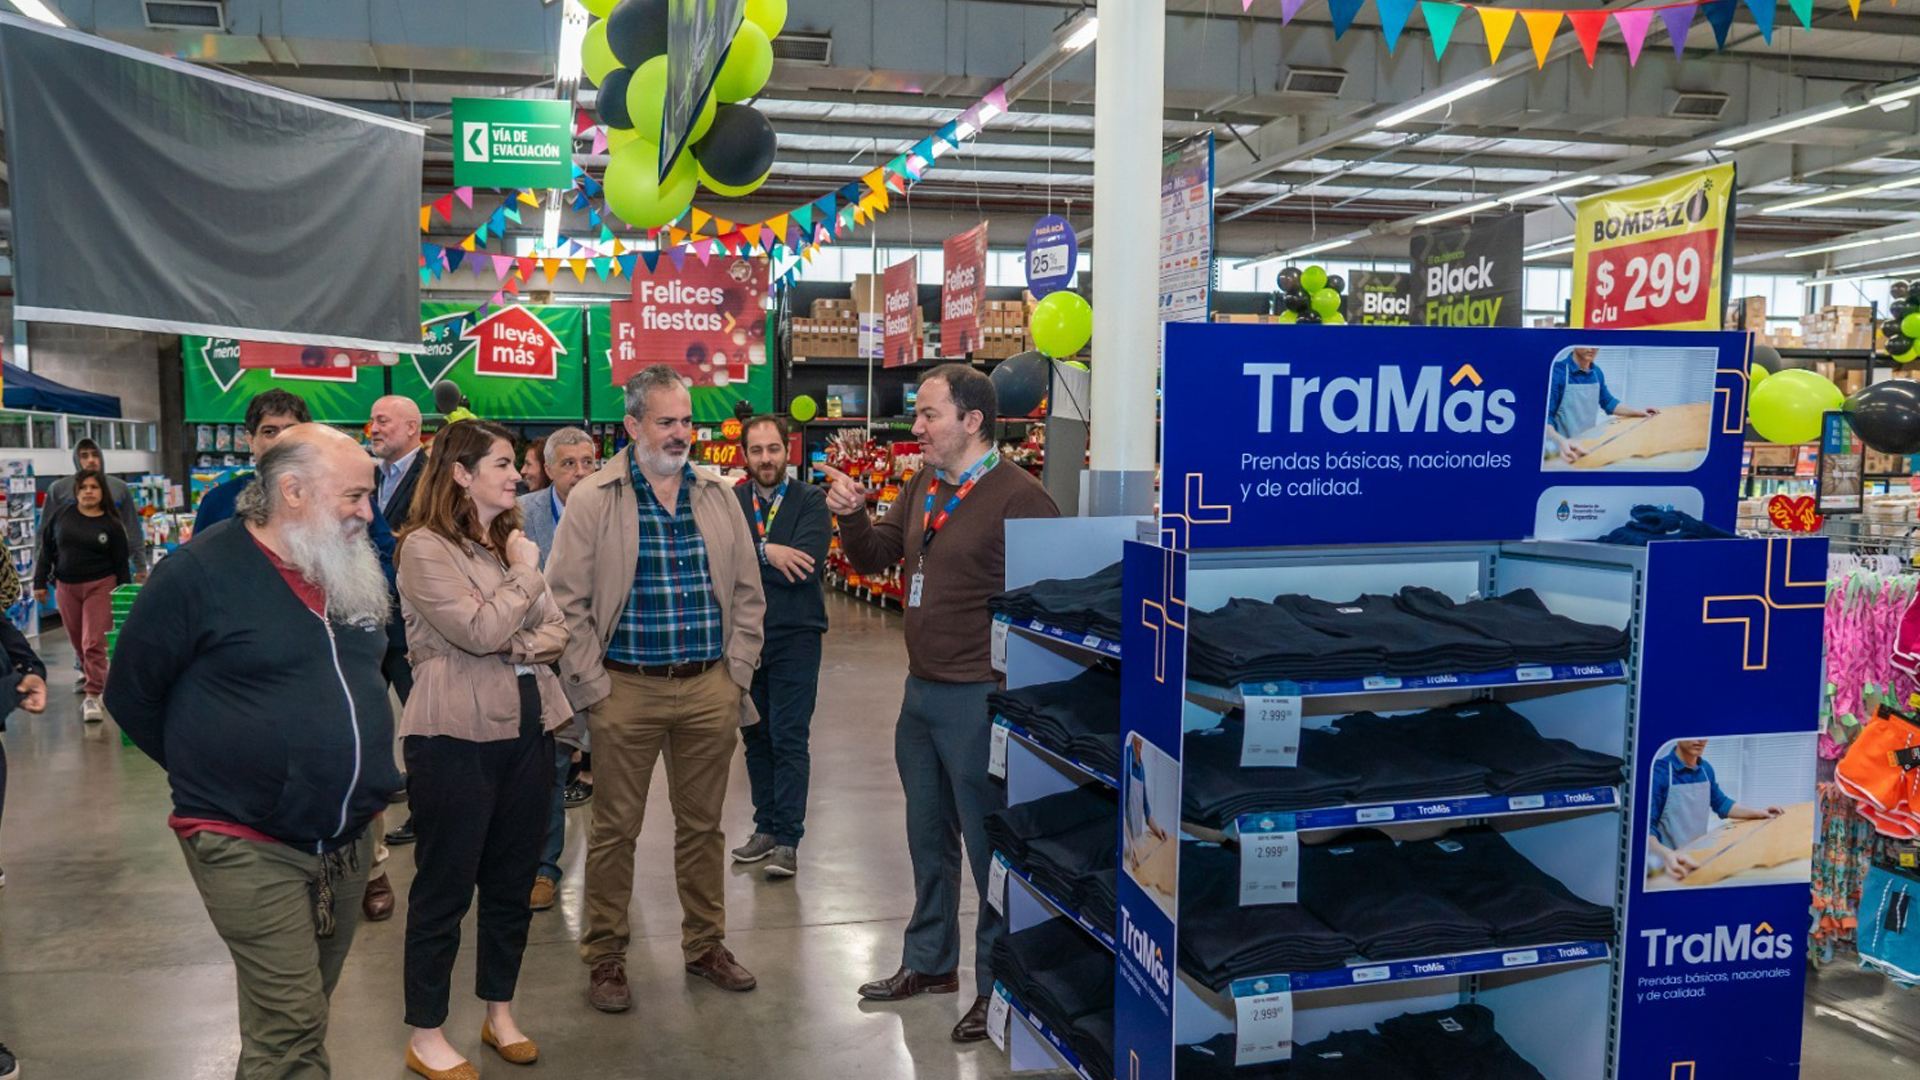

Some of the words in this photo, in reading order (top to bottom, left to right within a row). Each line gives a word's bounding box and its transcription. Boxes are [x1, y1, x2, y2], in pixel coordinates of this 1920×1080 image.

[492, 127, 511, 142] VÍA
[513, 130, 528, 142] DE
[493, 143, 560, 158] EVACUACIÓN
[946, 263, 975, 292] Felices
[1427, 256, 1494, 297] Black
[1624, 248, 1700, 311] 299
[641, 279, 724, 304] Felices
[886, 289, 909, 313] Felices
[642, 305, 722, 331] fiestas
[945, 294, 973, 320] fiestas
[1426, 295, 1503, 327] Friday
[1592, 303, 1618, 323] c/u
[493, 322, 544, 346] llevás
[886, 315, 908, 337] fiestas
[213, 345, 240, 359] meno
[493, 343, 535, 366] más
[1241, 452, 1320, 470] Prendas
[1325, 451, 1403, 471] básicas,
[1408, 450, 1511, 468] nacionales
[1240, 482, 1251, 502] y
[1256, 479, 1282, 497] de
[1287, 478, 1363, 496] calidad.
[1638, 975, 1682, 987] Prendas
[1685, 971, 1729, 984] básicas,
[1731, 967, 1790, 981] nacionales
[1637, 992, 1644, 1004] y
[1646, 989, 1661, 1001] de
[1663, 987, 1706, 999] calidad.
